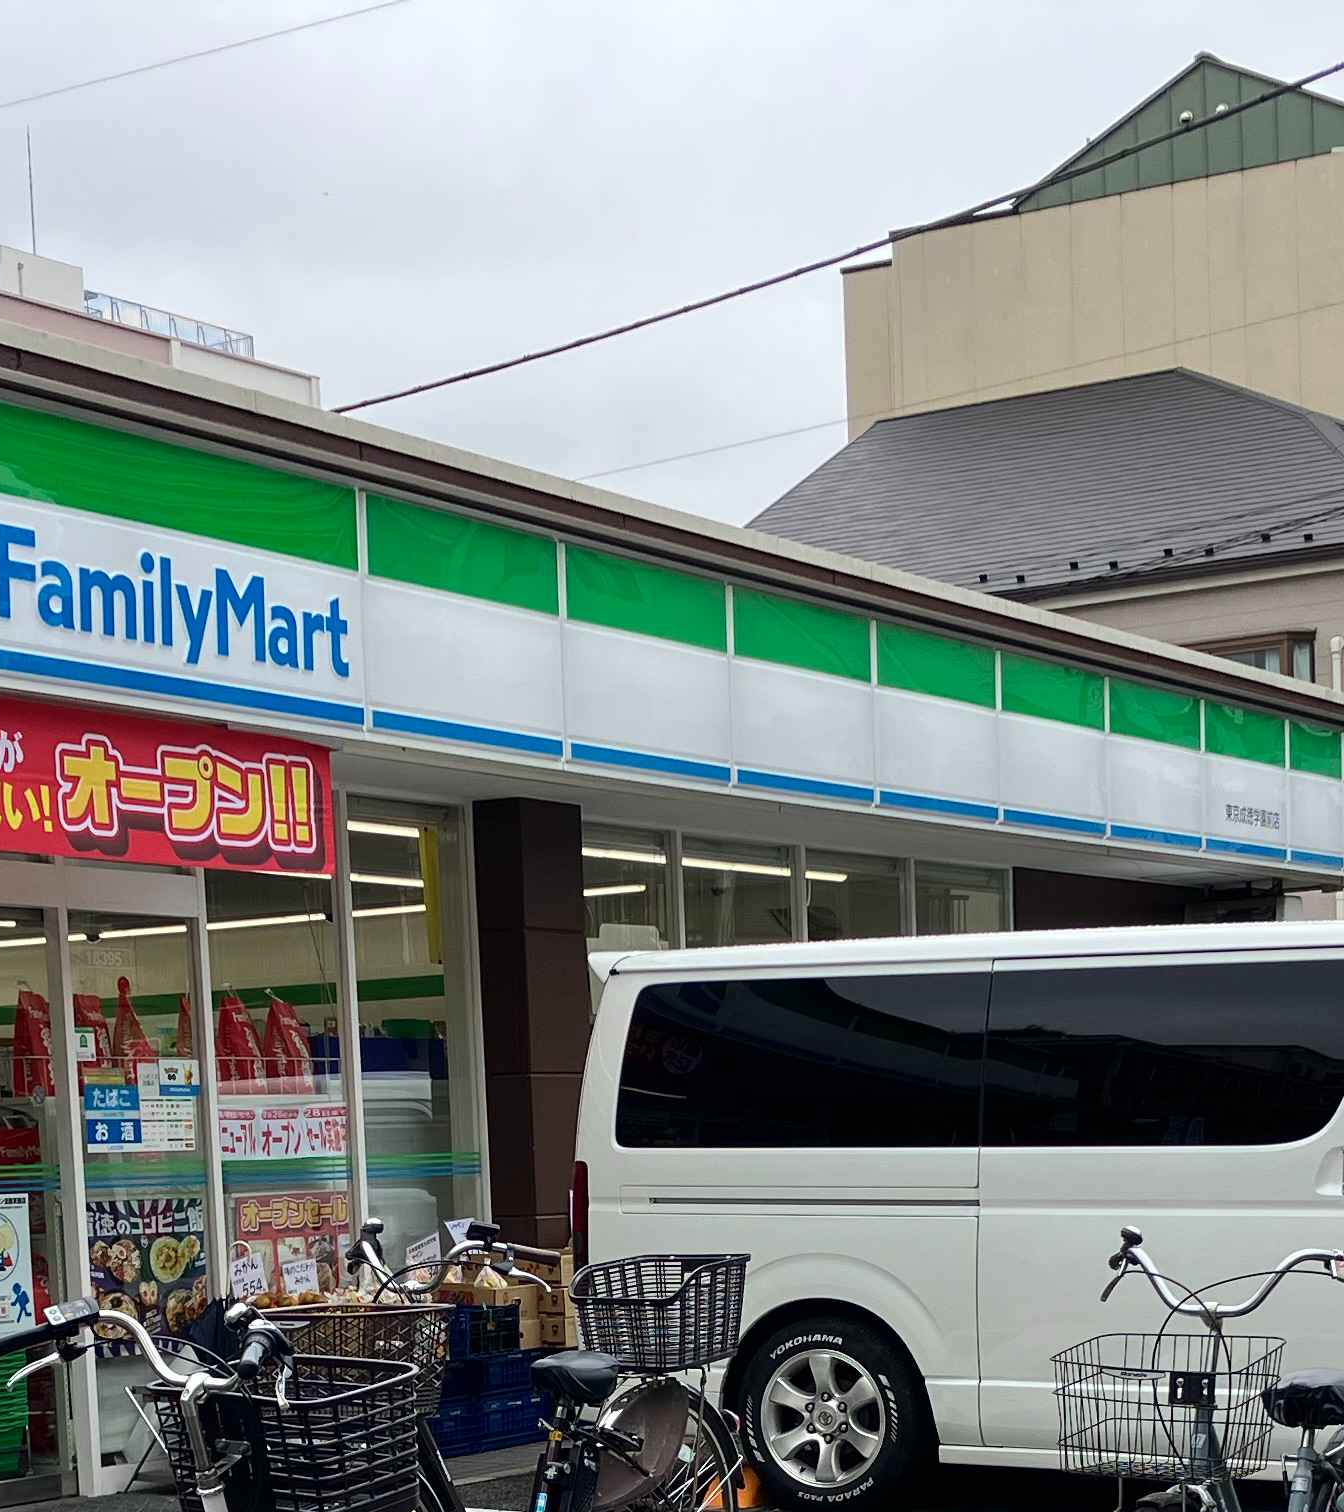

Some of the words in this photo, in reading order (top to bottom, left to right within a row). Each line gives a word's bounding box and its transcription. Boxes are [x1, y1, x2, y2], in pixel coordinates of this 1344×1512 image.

[56, 733, 318, 855] オープン!!
[92, 1087, 131, 1108] たばこ
[261, 1120, 303, 1157] オープン
[240, 1194, 351, 1233] オープンセール
[242, 1277, 264, 1297] 554
[769, 1333, 843, 1360] YOKOHAMA
[827, 1476, 874, 1503] PARADA
